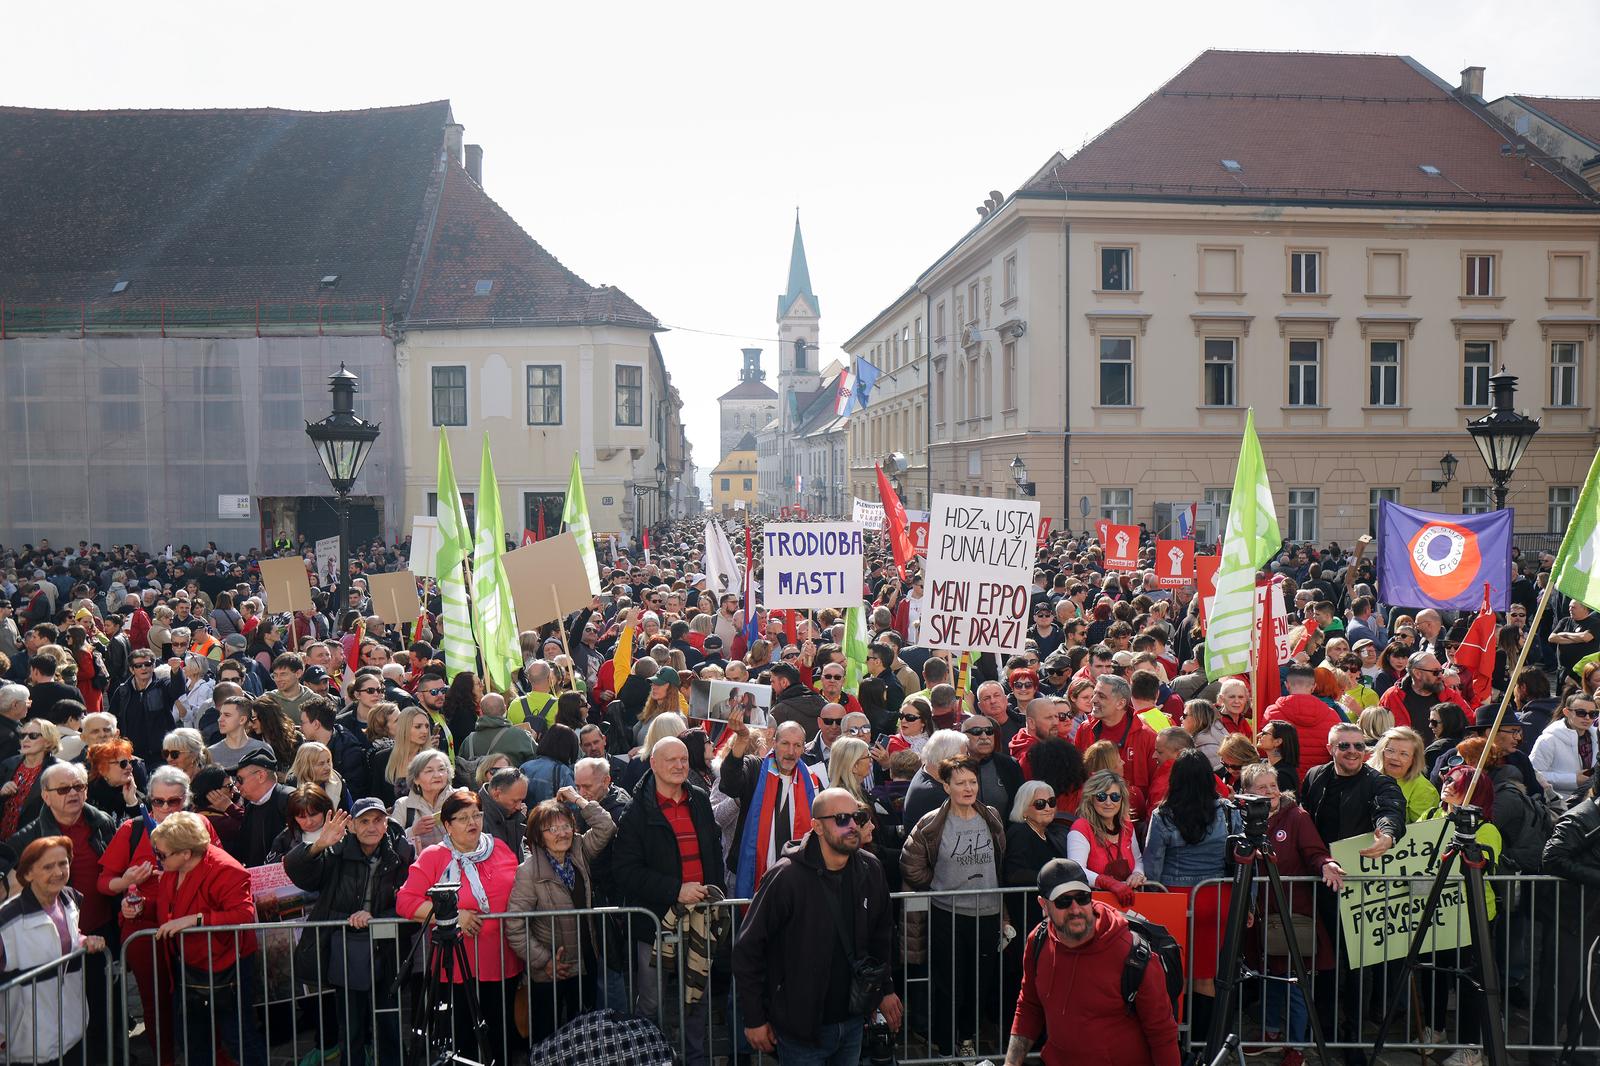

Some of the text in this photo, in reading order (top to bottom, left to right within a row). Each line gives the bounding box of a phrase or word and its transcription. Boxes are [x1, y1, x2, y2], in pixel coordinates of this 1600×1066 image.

[997, 510, 1035, 537] USTA
[764, 531, 863, 557] TRODIOBA
[941, 535, 1028, 571] PUNA LAŽI,
[778, 572, 845, 594] MASTI
[931, 580, 1027, 619] MENI EPPO
[929, 615, 1021, 649] SVE DRAŽI
[1352, 891, 1465, 934] pravosna
[1372, 910, 1445, 946] gadot
